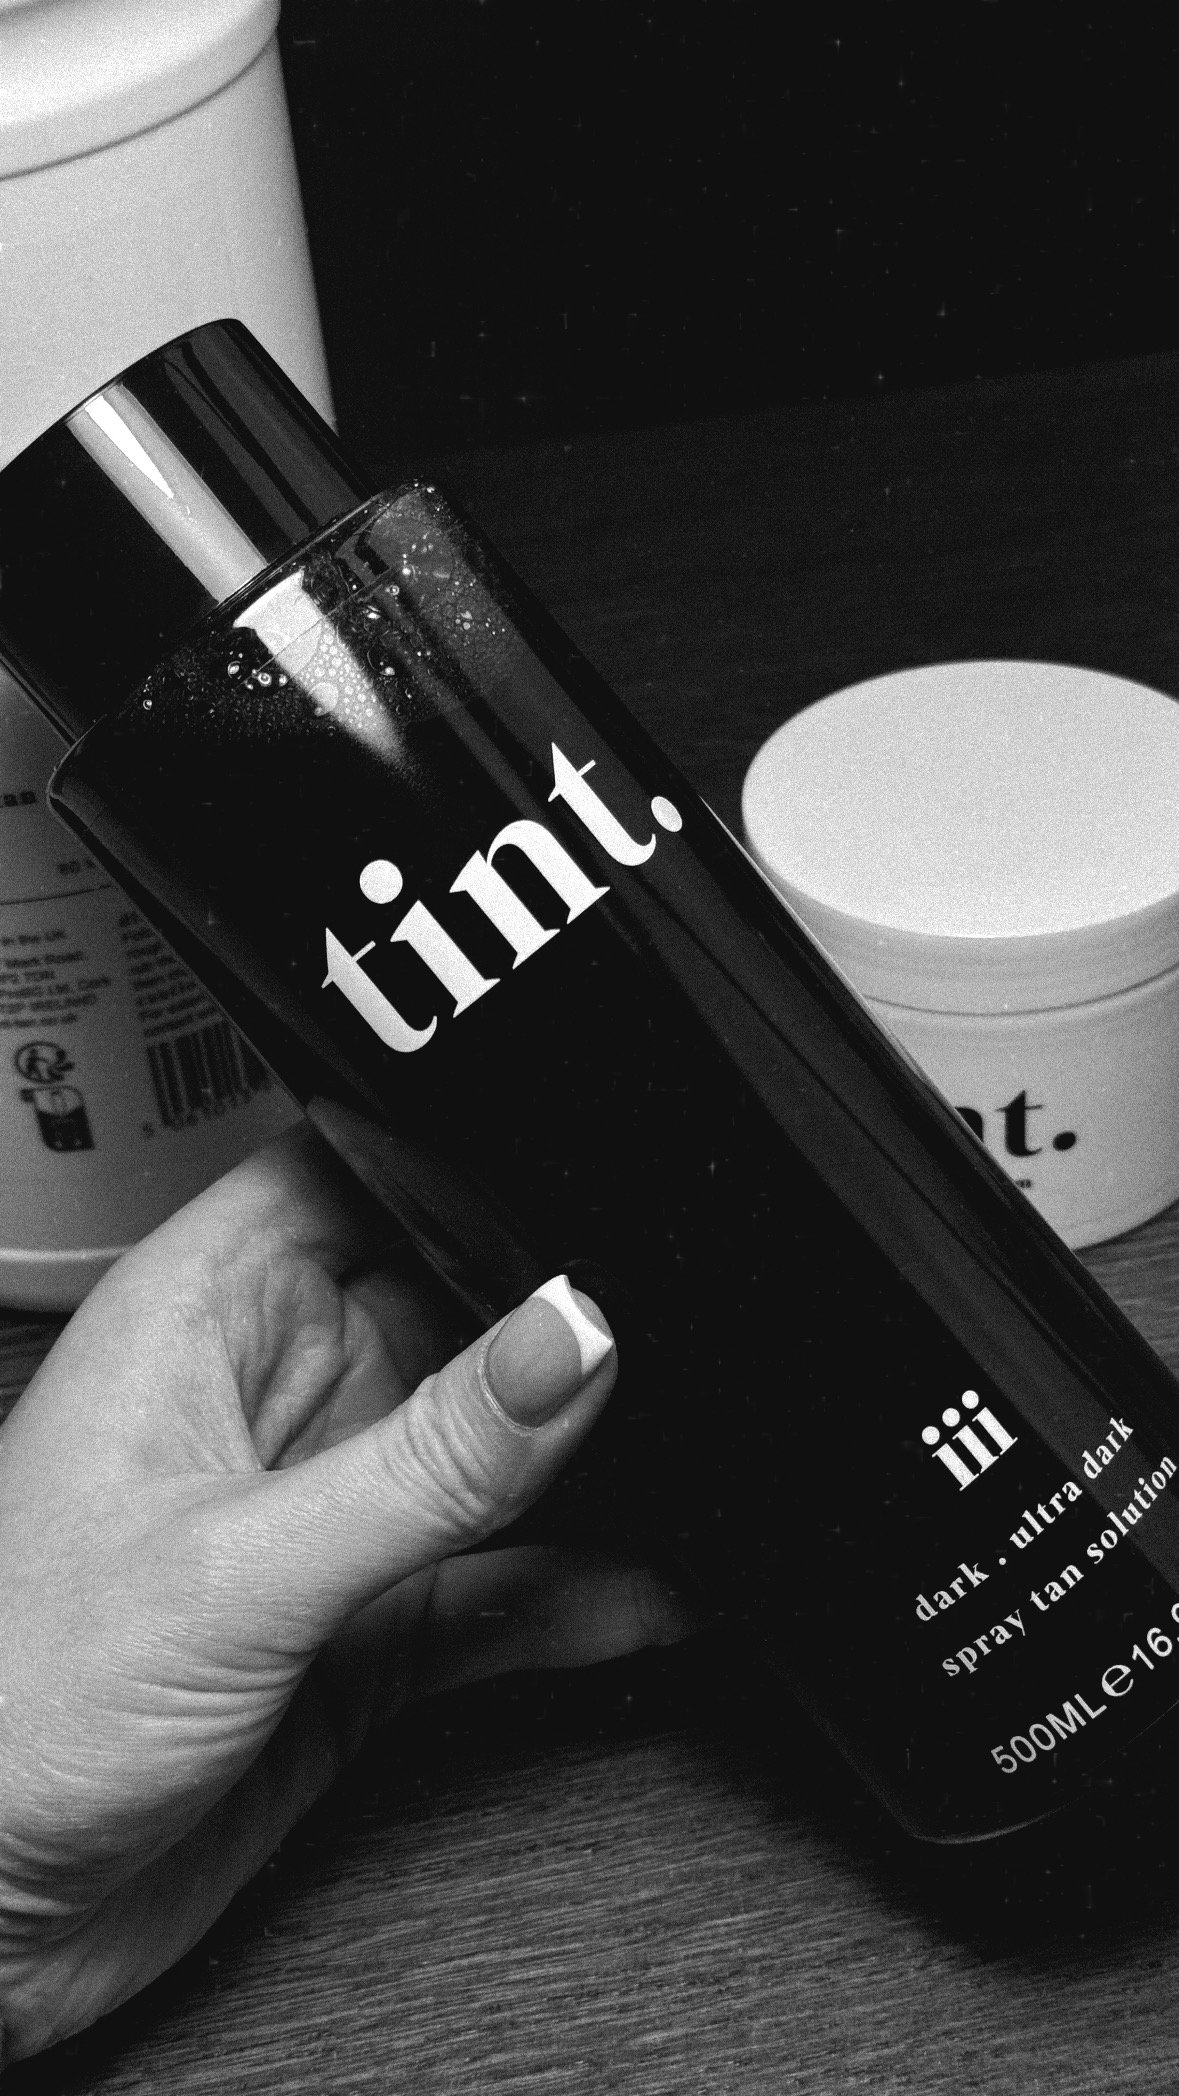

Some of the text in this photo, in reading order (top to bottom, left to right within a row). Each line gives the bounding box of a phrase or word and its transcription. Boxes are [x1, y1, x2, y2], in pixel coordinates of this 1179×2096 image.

[322, 742, 682, 1052] tint.
[916, 1563, 989, 1621] dark
[1010, 1482, 1082, 1549] ultra
[1082, 1417, 1133, 1479] dark
[922, 1390, 1018, 1491] iii
[942, 1456, 1178, 1677] spray tan solution
[991, 1694, 1107, 1774] 500ML
